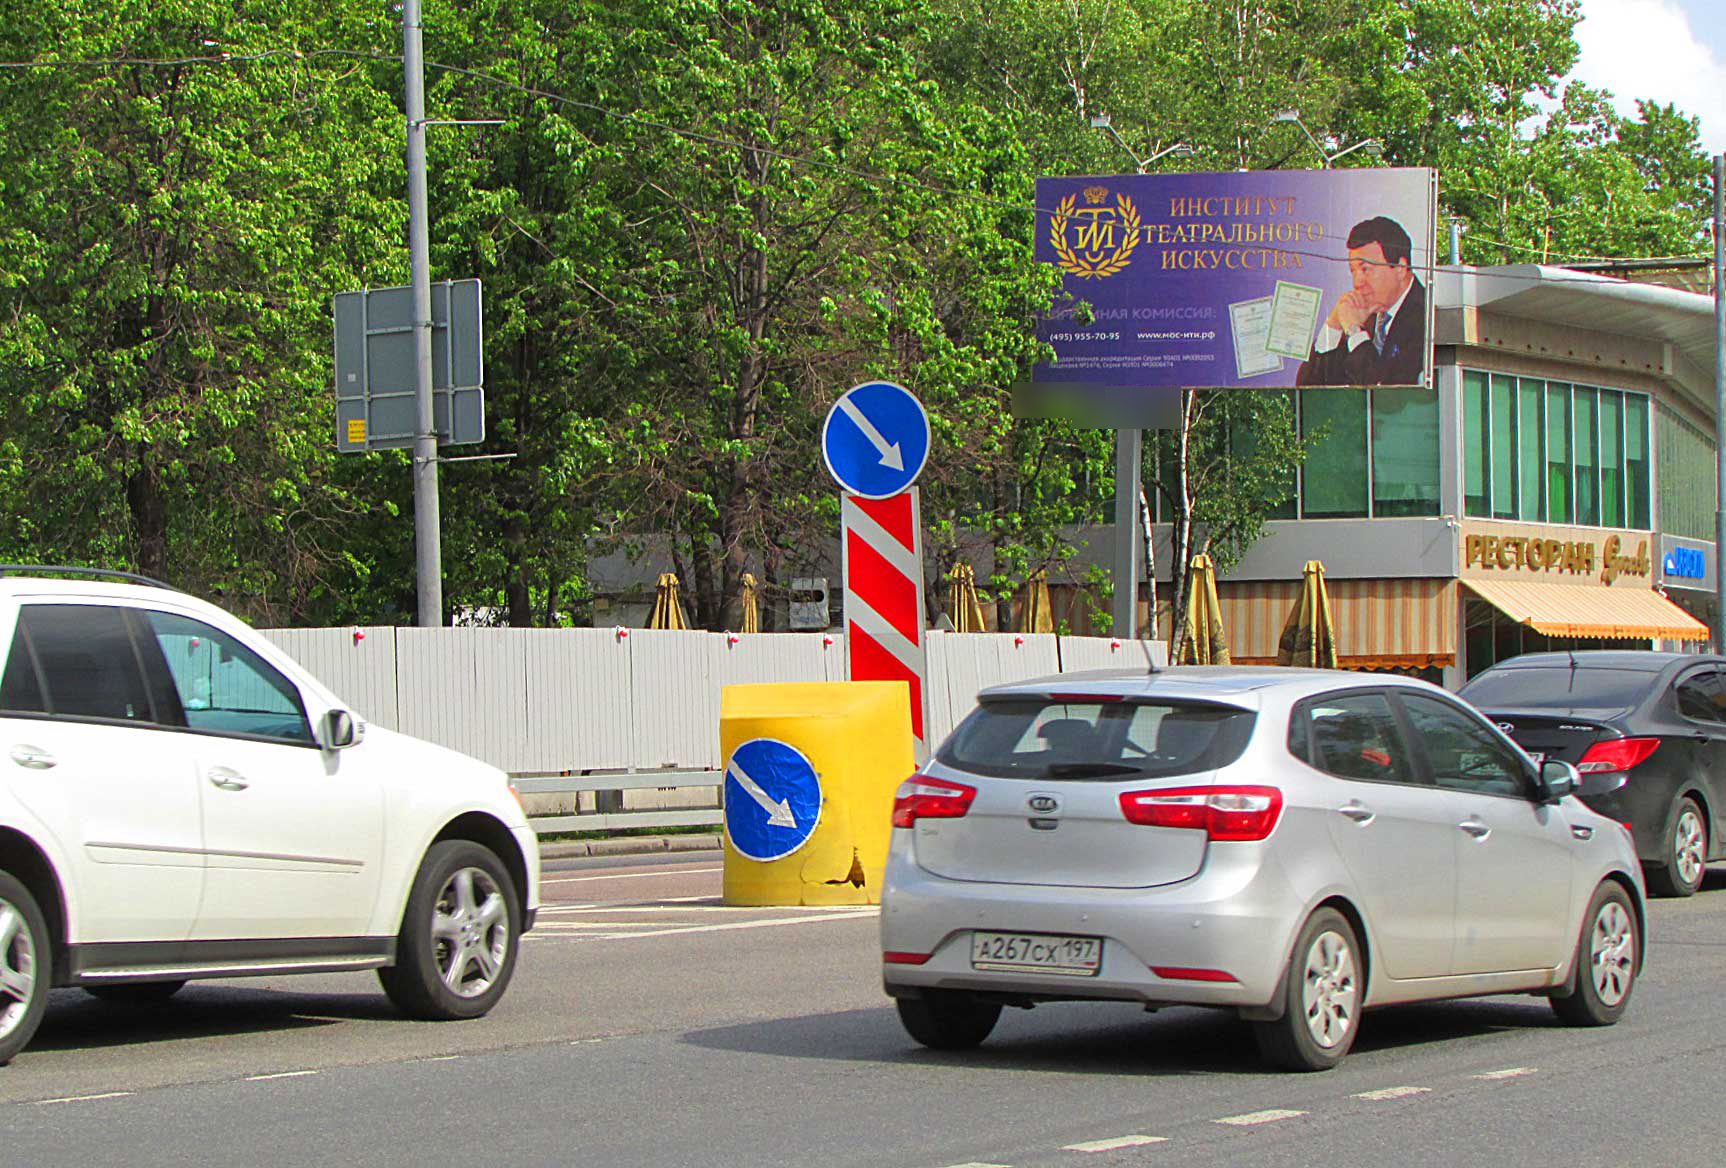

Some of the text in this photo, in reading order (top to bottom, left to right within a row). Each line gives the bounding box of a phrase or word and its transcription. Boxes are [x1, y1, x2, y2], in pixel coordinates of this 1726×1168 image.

[1169, 196, 1297, 217] ИНСТИТУТ
[1143, 221, 1325, 244] ТЕАТРАЛЬНОГО
[1160, 248, 1304, 271] ИСКУССТВА
[1049, 332, 1120, 342] (495) 955-70-95
[1465, 534, 1595, 576] РЕСТОРАН
[1062, 939, 1095, 958] 197
